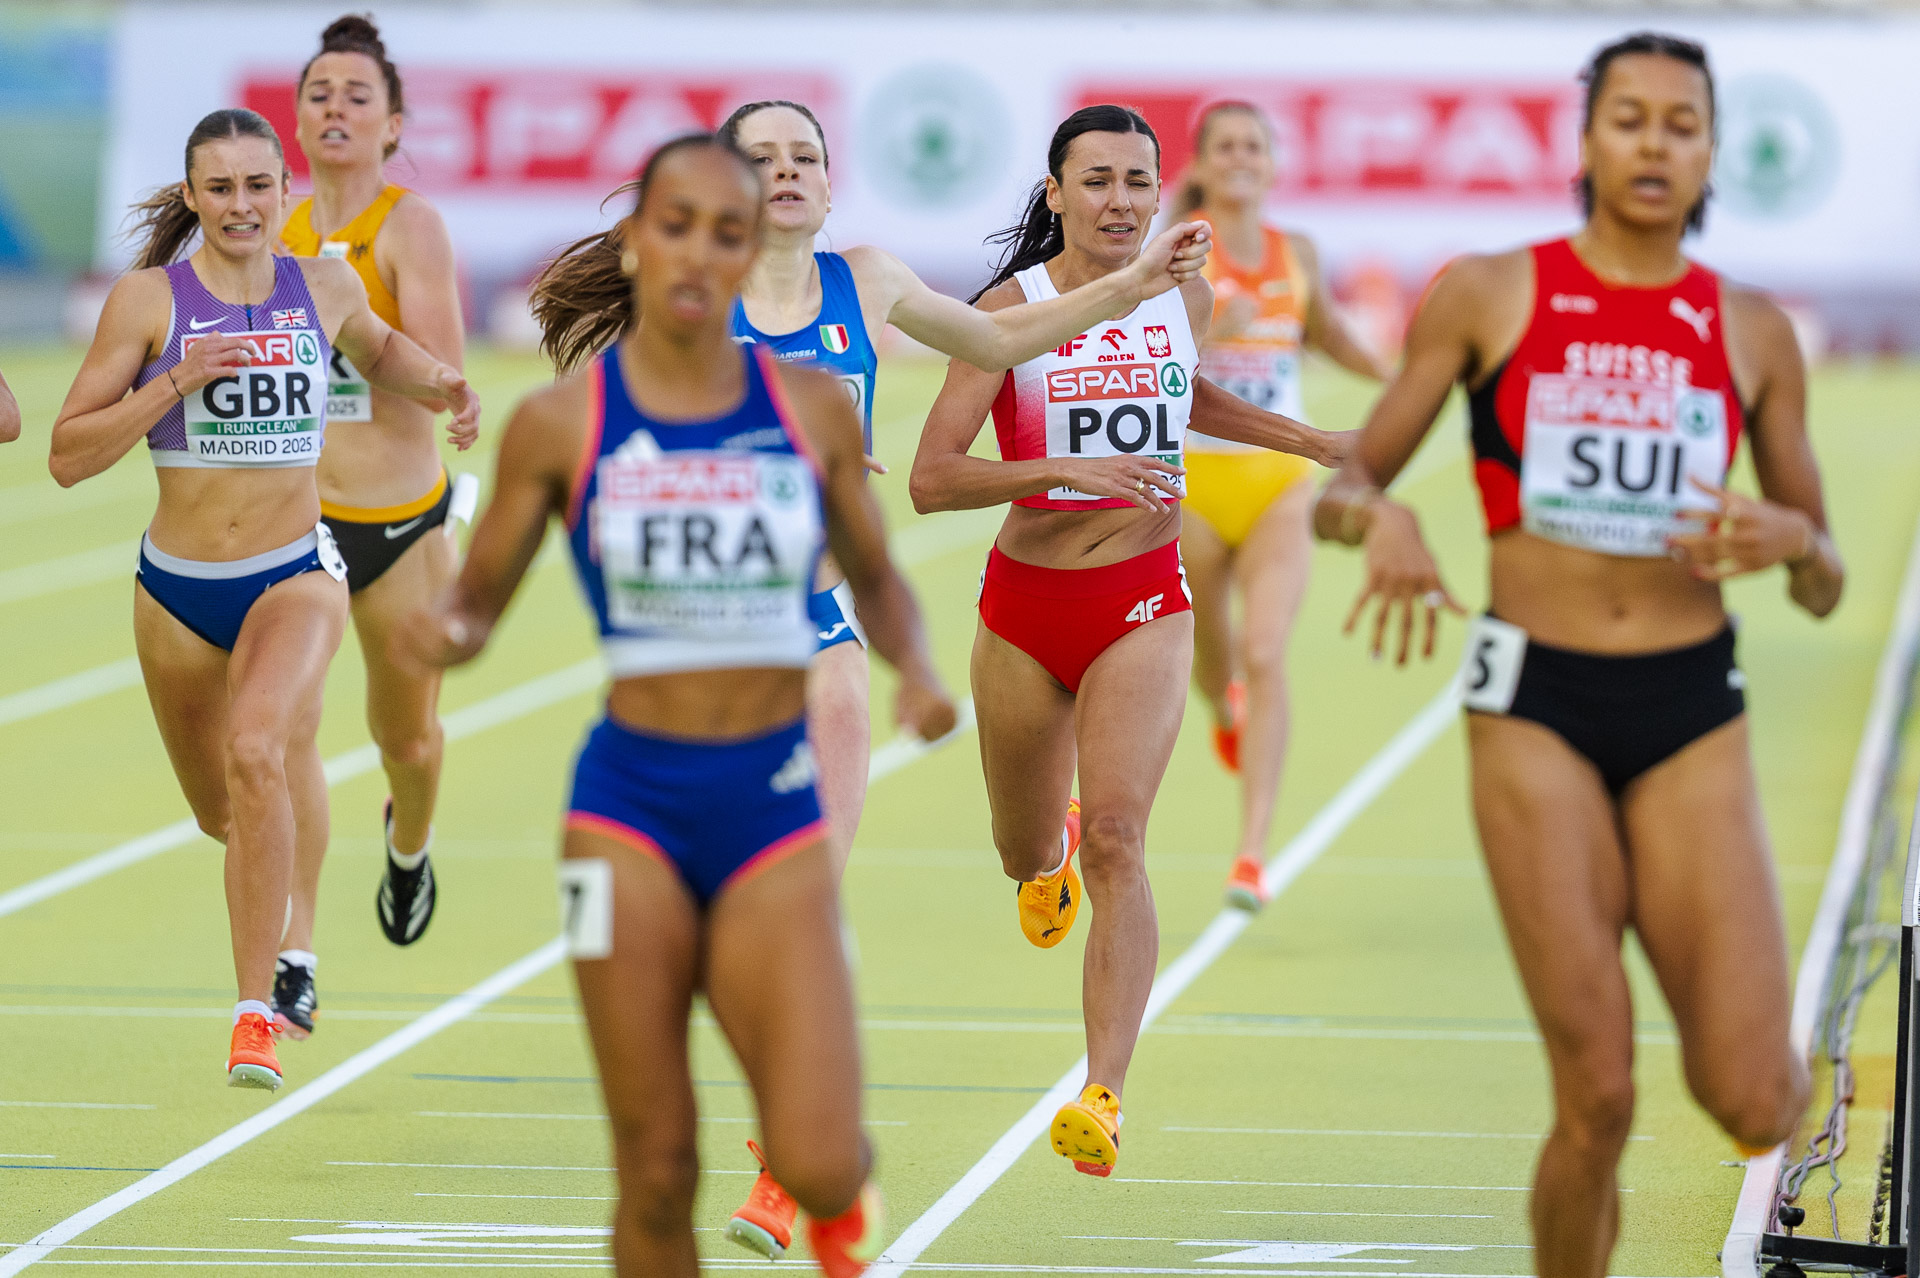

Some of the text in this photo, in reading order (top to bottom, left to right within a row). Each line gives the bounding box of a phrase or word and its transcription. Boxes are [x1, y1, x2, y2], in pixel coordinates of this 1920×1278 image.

[1050, 367, 1157, 398] SPAR
[1563, 341, 1694, 390] SUISSE
[202, 371, 311, 419] GBR
[200, 437, 312, 455] MADRID 2025
[217, 423, 221, 434] I
[223, 422, 254, 434] RUN
[1068, 403, 1179, 454] POL
[1567, 433, 1684, 496] SUI
[640, 511, 783, 574] FRA
[1125, 592, 1164, 623] 4F
[1471, 637, 1494, 691] 5
